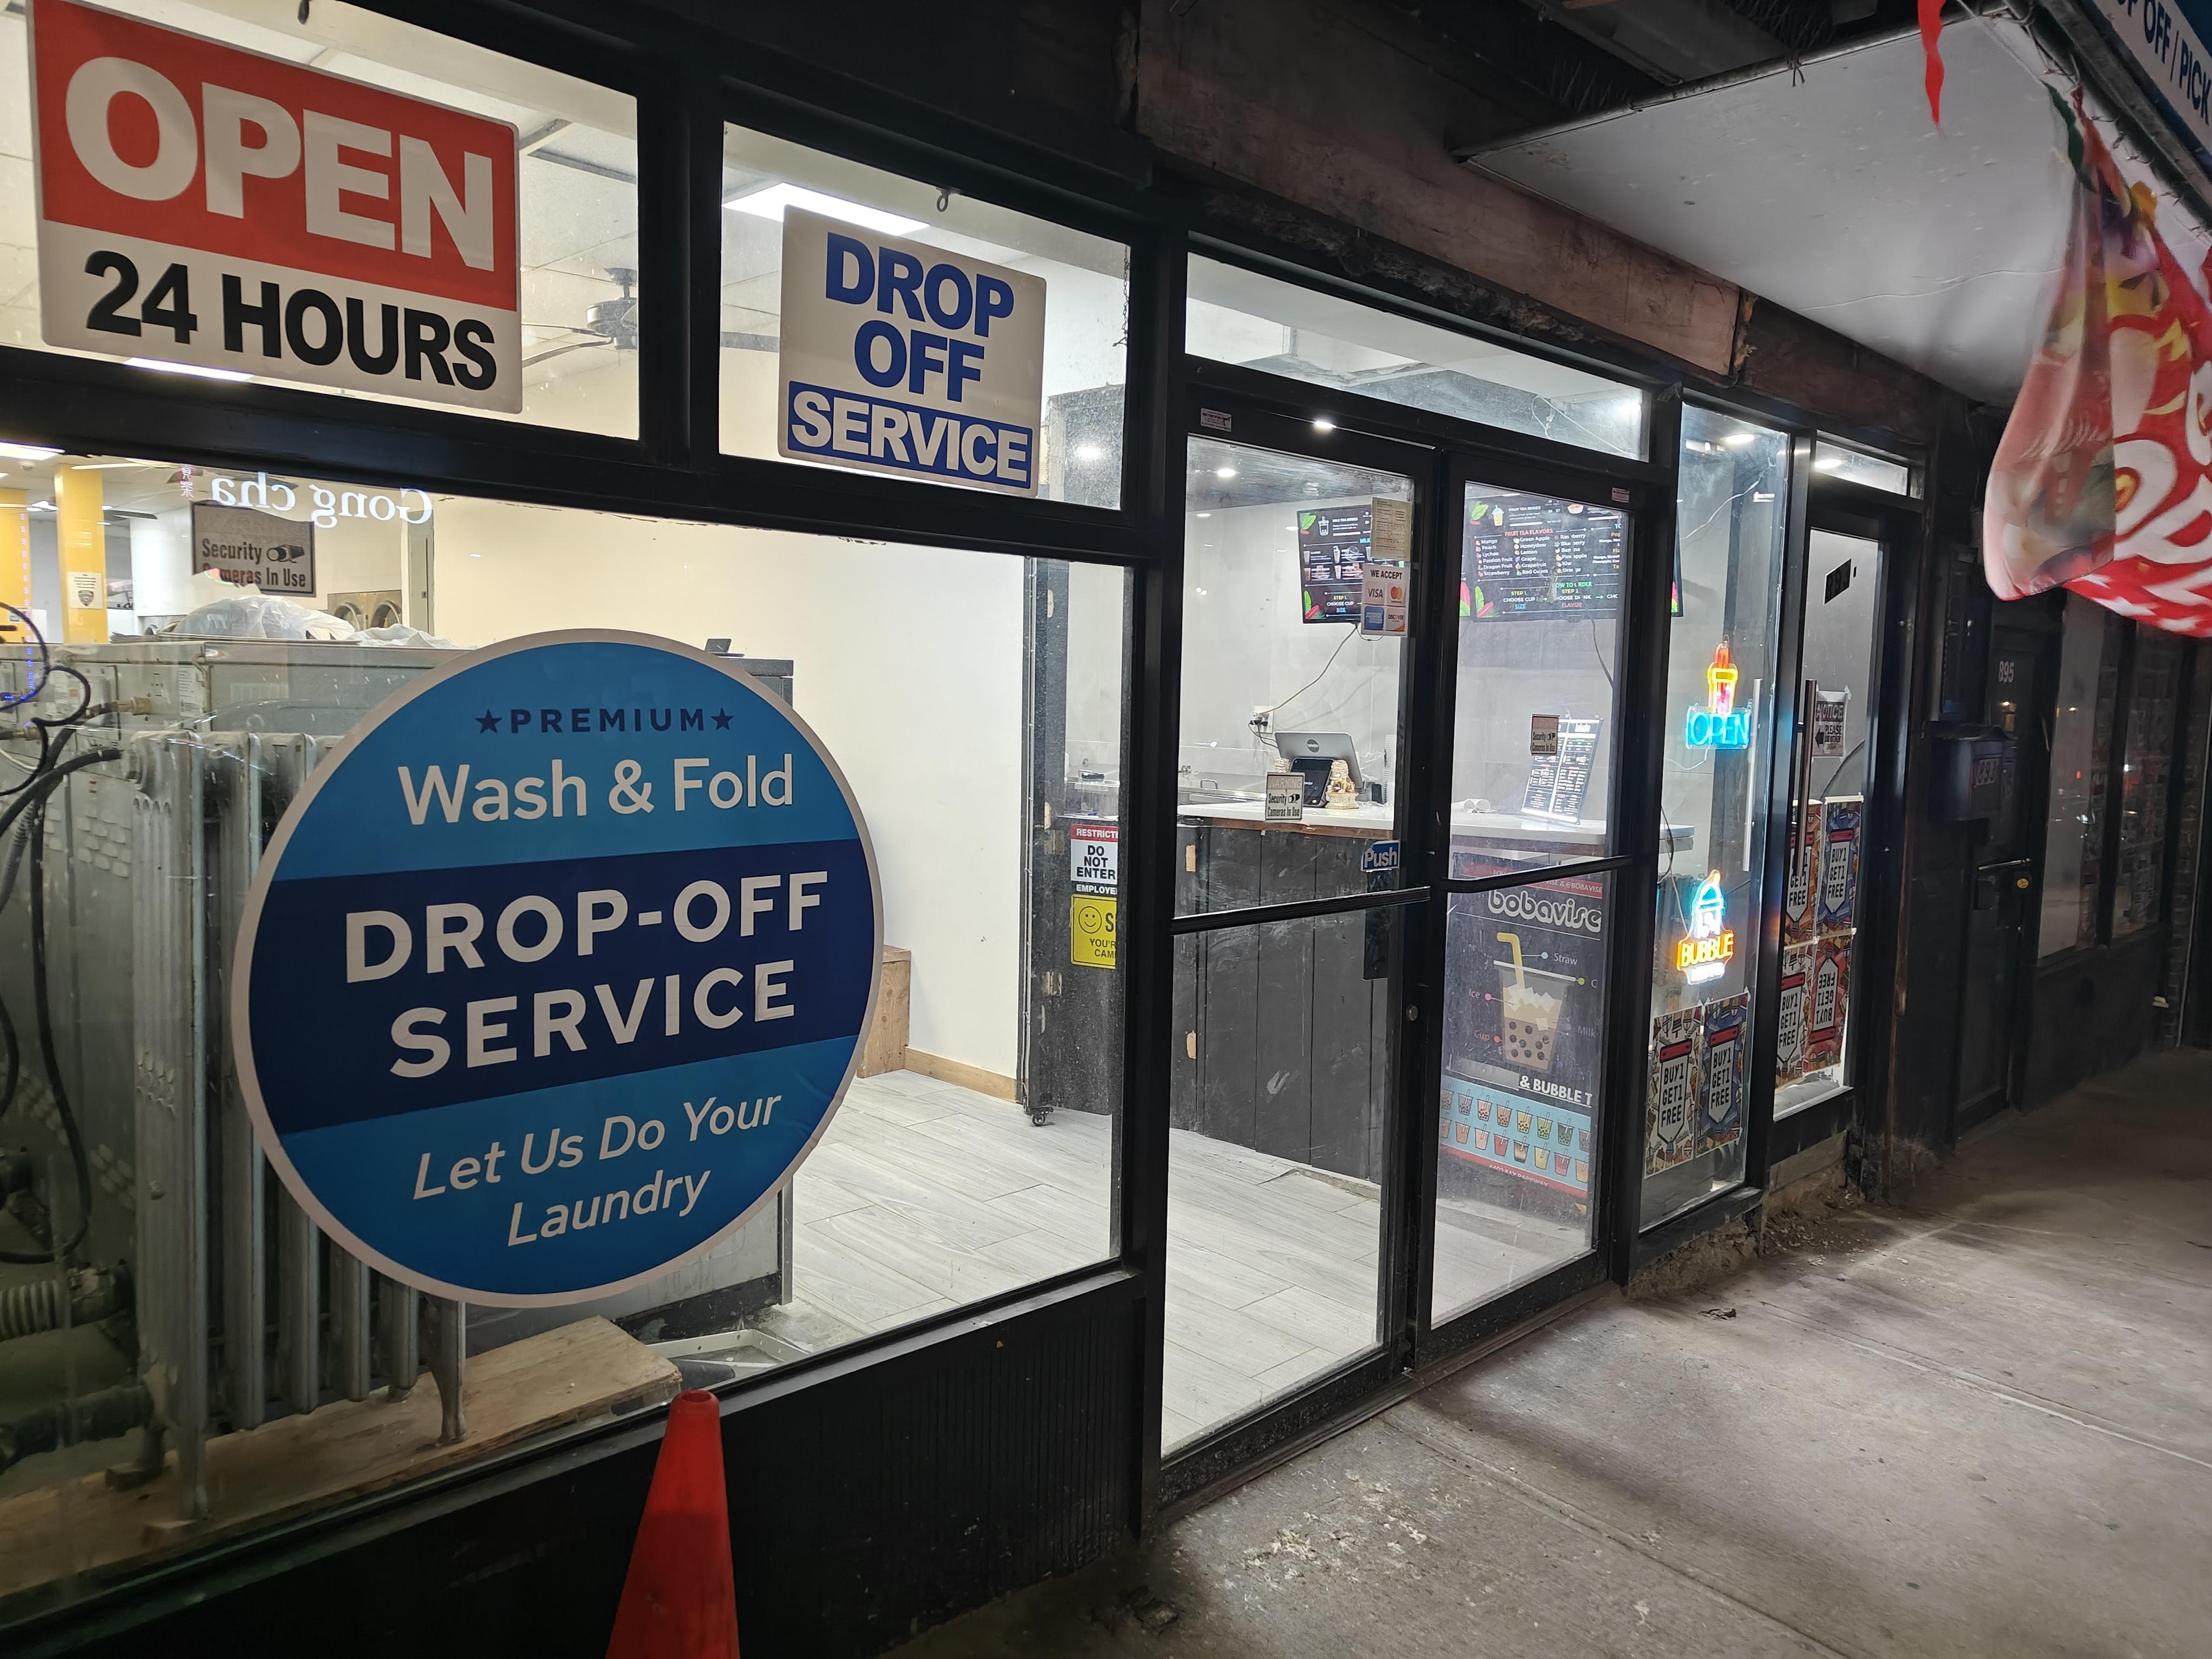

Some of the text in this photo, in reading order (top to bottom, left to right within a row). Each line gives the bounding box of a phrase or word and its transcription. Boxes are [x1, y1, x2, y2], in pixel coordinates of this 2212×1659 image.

[2144, 0, 2171, 64] OFF
[2179, 39, 2211, 126] PICK
[65, 57, 494, 272] OPEN
[826, 232, 1014, 338] DROP
[85, 251, 497, 390] 24 HOURS
[854, 320, 984, 402] OFF
[791, 391, 1028, 482] SERVICE
[202, 538, 262, 565] Security
[203, 563, 306, 588] meras In Use
[1371, 570, 1402, 579] WE ACCEPT
[1368, 589, 1383, 598] VISA
[1999, 661, 2014, 683] 895
[511, 707, 705, 734] PREMIUM
[1816, 704, 1844, 719] NOTICE
[1533, 732, 1546, 742] Security
[1690, 712, 1750, 745] OPEN
[1825, 725, 1842, 735] PLEASE
[1532, 743, 1546, 752] Cameras
[1546, 744, 1549, 752] In
[397, 753, 794, 825] Wash & Fold
[1270, 778, 1302, 789] WARNING
[1269, 793, 1287, 806] Security
[1267, 807, 1300, 817] Cameras In Use
[1088, 845, 1104, 856] DO
[1364, 847, 1397, 868] Push
[1831, 847, 1846, 864] BUY1
[1084, 856, 1108, 868] NOT
[1077, 867, 1116, 880] ENTER
[1830, 865, 1845, 881] GET1
[1076, 884, 1117, 895] EMPLOYE
[1566, 882, 1602, 893] @BOBAVISE
[1827, 883, 1844, 900] FREE
[1789, 889, 1806, 908] FREE
[1488, 890, 1602, 933] bobavise
[346, 871, 828, 984] DROP-OFF
[1553, 953, 1577, 966] Straw
[1681, 933, 1734, 967] BUBBLE
[1819, 972, 1835, 990] FREE
[1469, 989, 1480, 998] Ice
[1782, 993, 1798, 1011] BUY1
[389, 959, 796, 1078] SERVICE
[1780, 1011, 1796, 1030] GET1
[1474, 1029, 1490, 1041] Cup
[1577, 1026, 1595, 1038] Milk
[1779, 1029, 1796, 1049] FREE
[1713, 1047, 1731, 1069] BUY1
[1664, 1063, 1684, 1085] BUY1
[1712, 1067, 1730, 1089] GET1
[1520, 1075, 1530, 1089] &
[1533, 1078, 1582, 1103] BUBBLE
[1662, 1083, 1682, 1106] GET1
[1711, 1087, 1729, 1109] FREE
[1661, 1104, 1682, 1128] FREE
[413, 1094, 782, 1201] Let Us Do Your
[507, 1169, 711, 1247] Laundry
